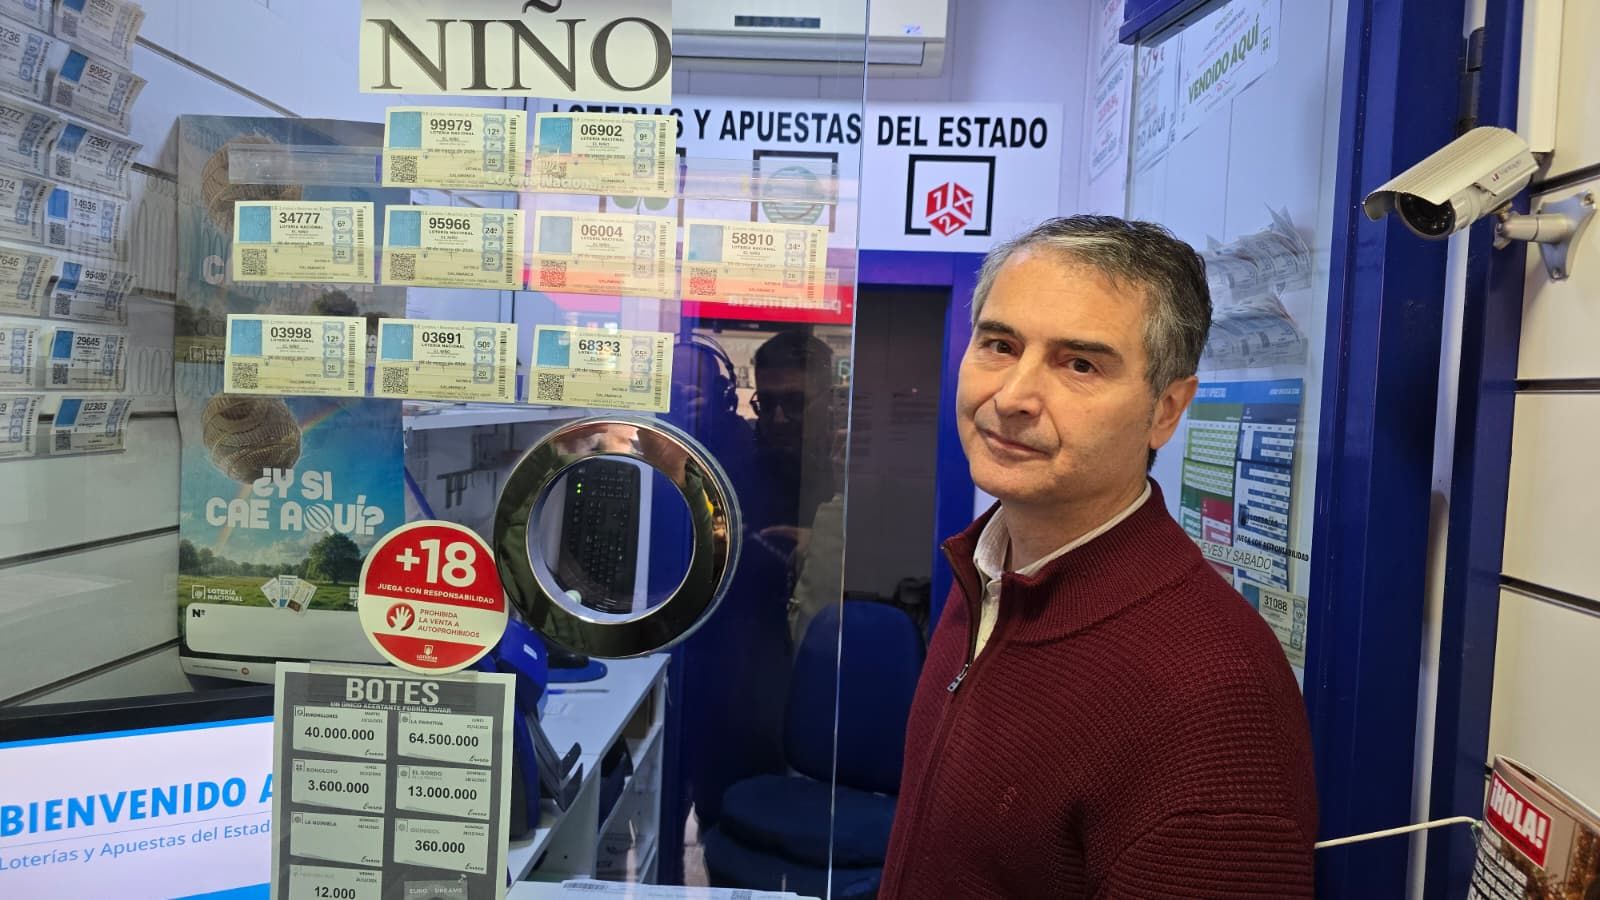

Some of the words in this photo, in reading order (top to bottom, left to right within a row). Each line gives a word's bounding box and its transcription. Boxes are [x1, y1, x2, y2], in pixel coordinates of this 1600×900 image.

[366, 0, 672, 92] NIÑO
[1188, 51, 1230, 104] VENDIDO
[1229, 13, 1260, 67] AQUÍ
[430, 118, 472, 132] 99979
[580, 124, 622, 137] 06902
[693, 109, 711, 140] Y
[719, 110, 862, 144] APUESTAS
[877, 115, 928, 146] DEL
[938, 116, 1048, 149] ESTADO
[279, 212, 321, 224] 34777
[429, 217, 471, 230] 95966
[581, 224, 623, 237] 06004
[731, 232, 774, 246] 58910
[270, 327, 312, 339] 03998
[422, 331, 462, 344] 03691
[578, 339, 621, 353] 68333
[252, 467, 294, 498] ¿Y
[301, 470, 333, 500] SI
[206, 497, 270, 530] CAE
[280, 494, 385, 536] AQUÍ?
[1226, 548, 1233, 559] Y
[395, 538, 477, 588] +18
[207, 594, 243, 602] NACIONAL
[377, 583, 403, 592] JUEGA
[405, 586, 422, 594] CON
[423, 589, 495, 604] RESPONSABILIDAD
[1264, 595, 1288, 611] 31088
[420, 608, 458, 619] PROHIBIDA
[430, 618, 452, 627] VENTA
[417, 625, 480, 638] AUTOPROHIBIDOS
[345, 677, 440, 706] BOTES
[304, 726, 375, 741] 40.000.000
[409, 732, 479, 747] 64.500.000
[308, 779, 369, 794] 3.600.000
[408, 785, 477, 801] 13.000.000
[0, 777, 247, 838] BIENVENIDO
[0, 849, 79, 871] Loterías
[83, 847, 95, 863] y
[100, 833, 185, 858] Apuestas
[192, 827, 218, 843] del
[415, 839, 465, 854] 360.000
[314, 885, 356, 900] 12.000
